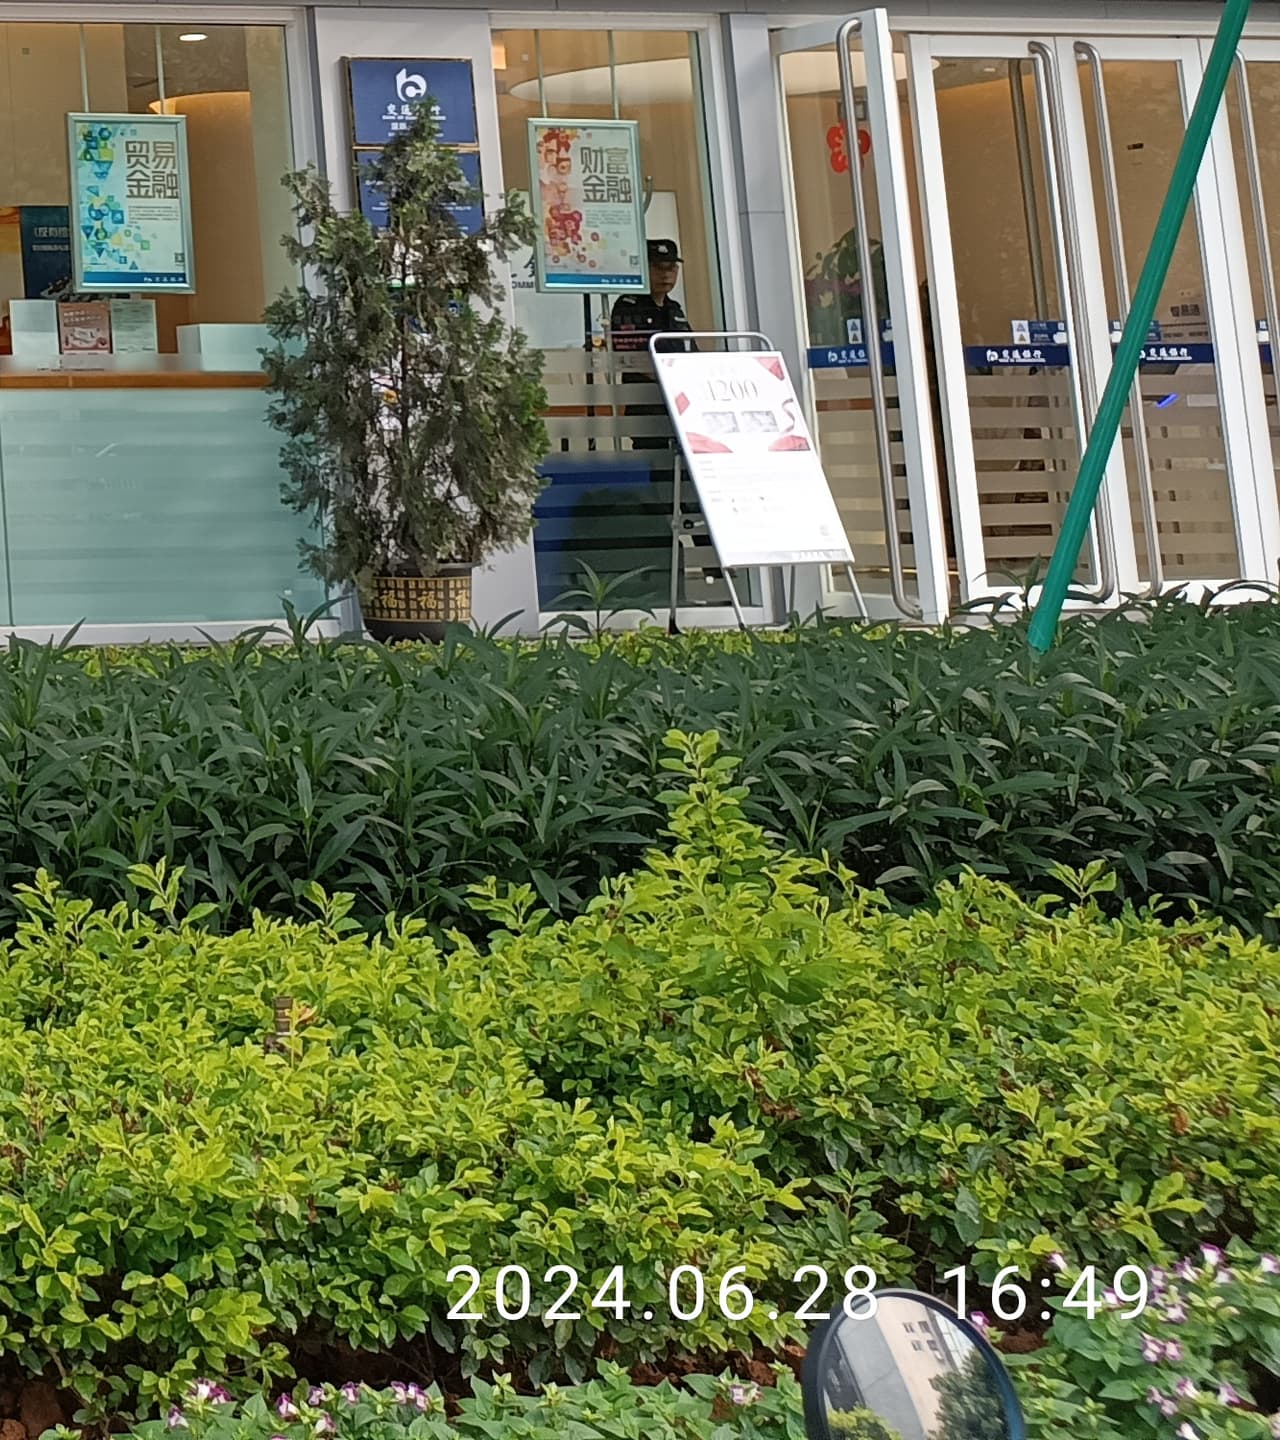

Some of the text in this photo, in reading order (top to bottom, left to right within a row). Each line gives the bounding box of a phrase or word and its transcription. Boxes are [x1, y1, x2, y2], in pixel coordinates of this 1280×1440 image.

[124, 140, 177, 169] 贸易
[579, 146, 630, 174] 财富
[124, 170, 180, 199] 金融
[582, 175, 633, 204] 金融
